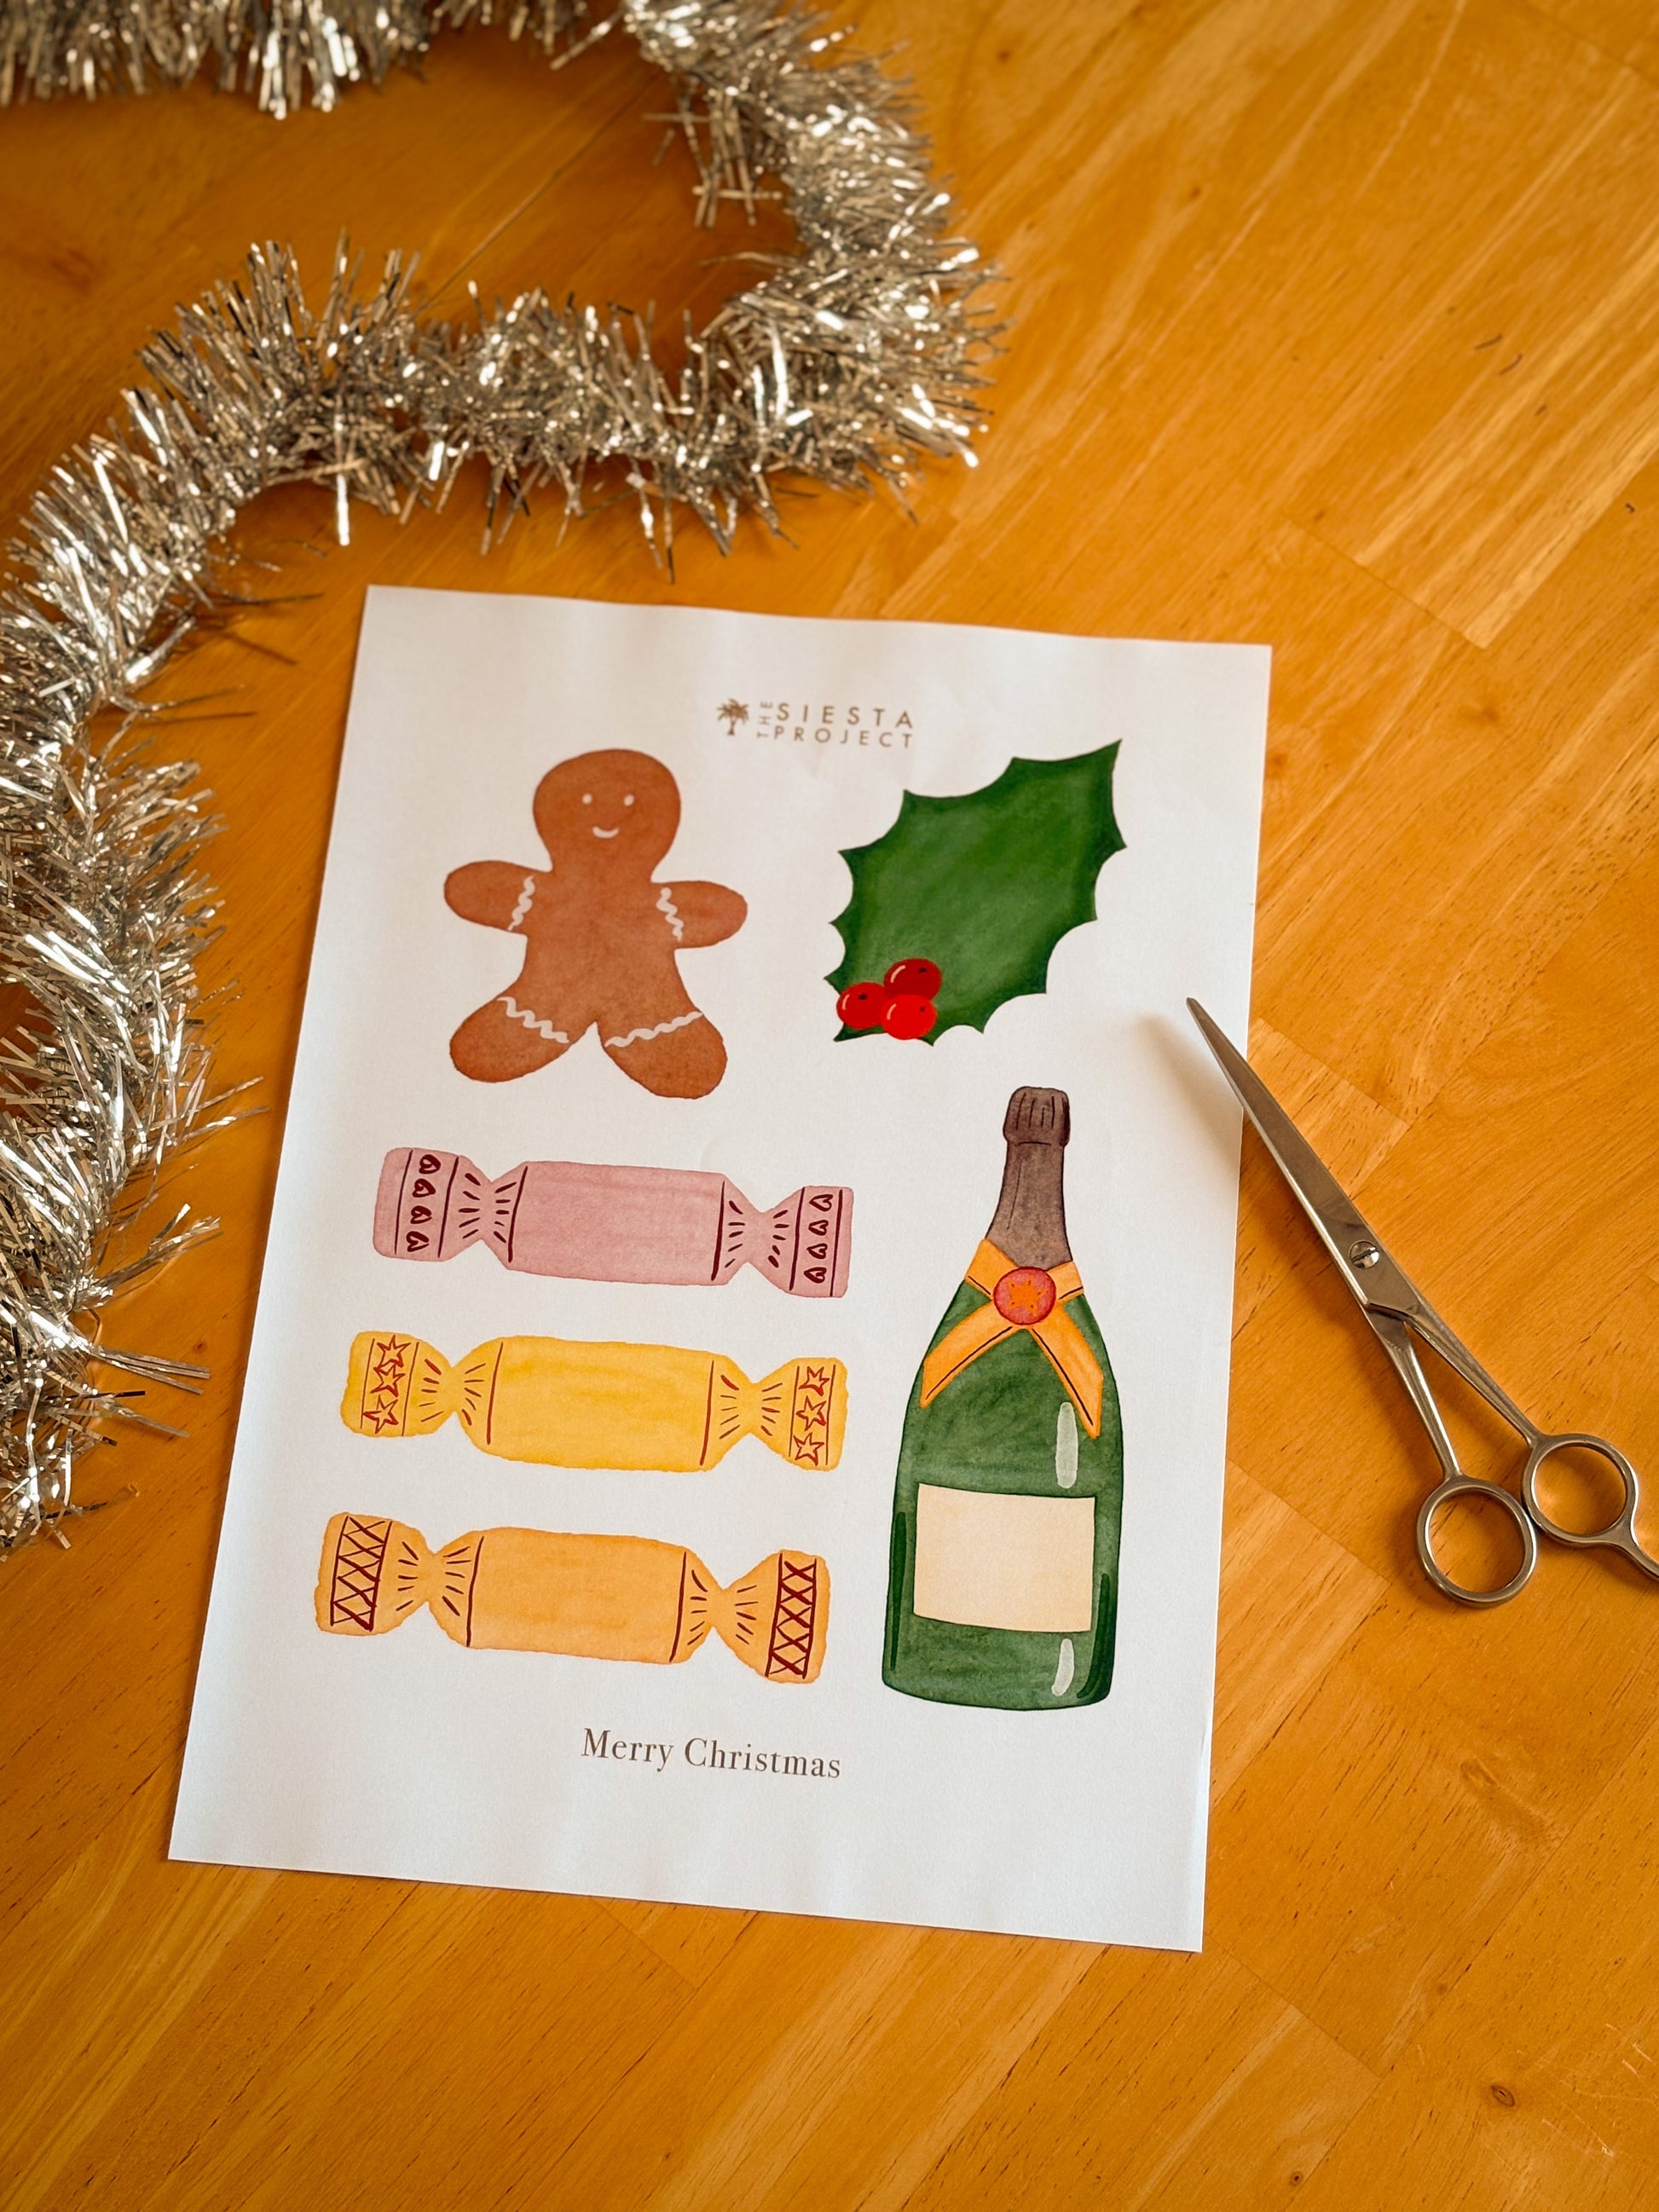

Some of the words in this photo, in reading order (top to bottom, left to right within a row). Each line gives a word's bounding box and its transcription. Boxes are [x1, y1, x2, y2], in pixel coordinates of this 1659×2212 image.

[757, 701, 773, 738] THE
[776, 702, 913, 729] SIESTA
[773, 725, 912, 748] PROJECT
[581, 1727, 674, 1772] Merry
[685, 1737, 841, 1779] Christmas
